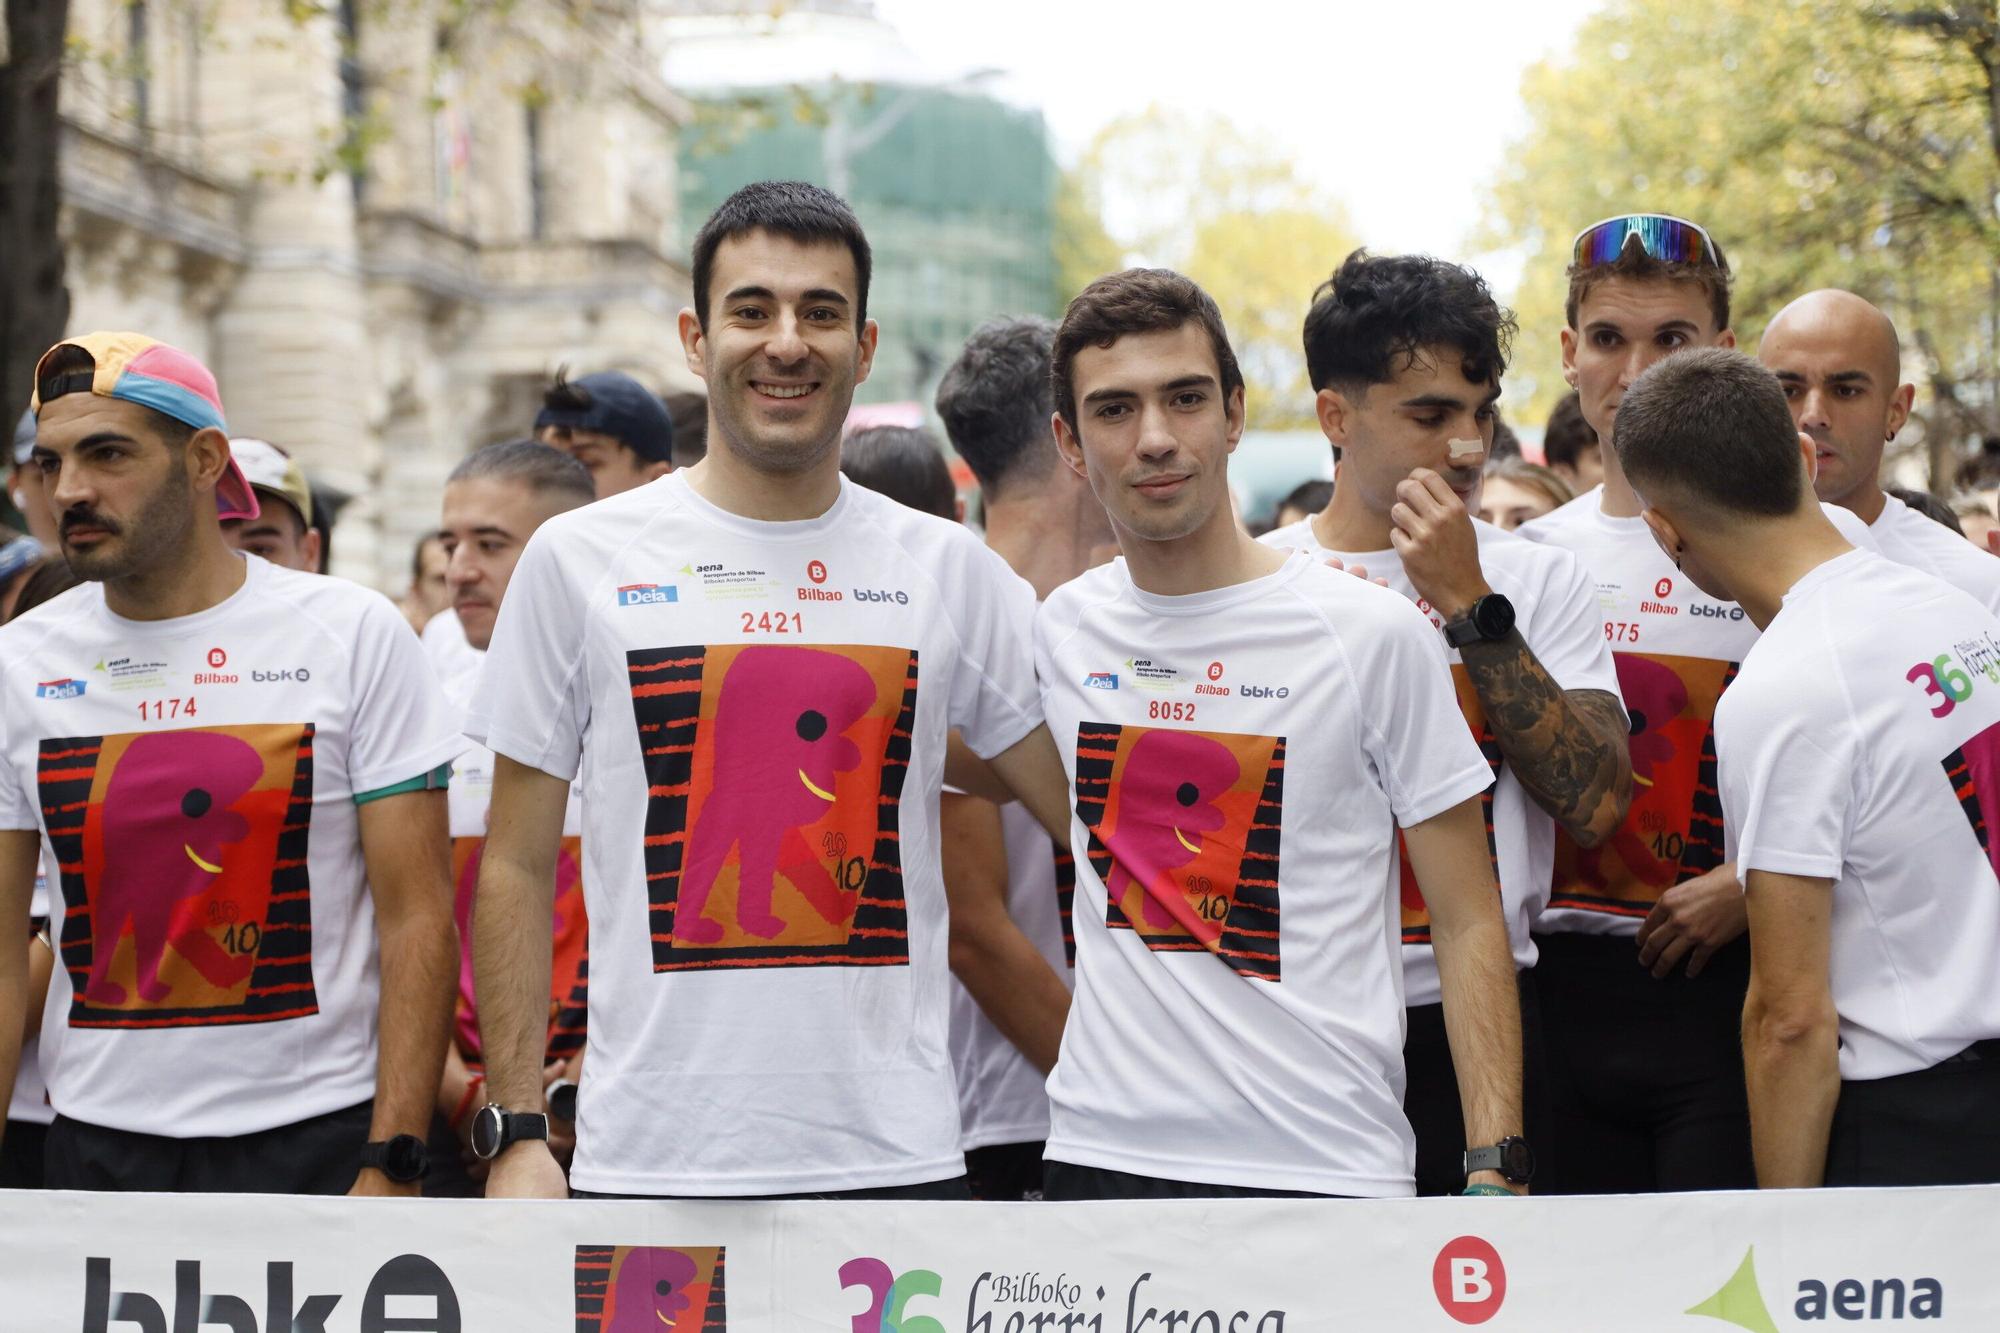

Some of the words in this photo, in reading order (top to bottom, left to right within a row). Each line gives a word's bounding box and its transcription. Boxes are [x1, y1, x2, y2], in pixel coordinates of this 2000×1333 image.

[695, 563, 723, 573] aena
[626, 588, 668, 605] Deia
[796, 587, 843, 602] Bilbao
[853, 588, 895, 604] bbk
[1640, 601, 1679, 616] Bilbao
[1689, 603, 1727, 620] bbk
[741, 611, 804, 633] 2421
[193, 673, 239, 685] Bilbao
[252, 670, 293, 682] bbk
[1089, 677, 1114, 689] Deia
[44, 684, 78, 700] Deia
[1194, 684, 1231, 697] Bilbao
[1240, 685, 1275, 699] bbk
[1905, 653, 1974, 719] 36
[137, 696, 198, 721] 1174
[1149, 700, 1196, 722] 8052
[822, 831, 848, 858] 10
[1651, 831, 1684, 860] 10
[835, 855, 866, 891] 10
[1197, 894, 1229, 921] 10
[222, 920, 260, 955] 10
[991, 1272, 1081, 1310] Bilboko
[1793, 1276, 1944, 1322] aena
